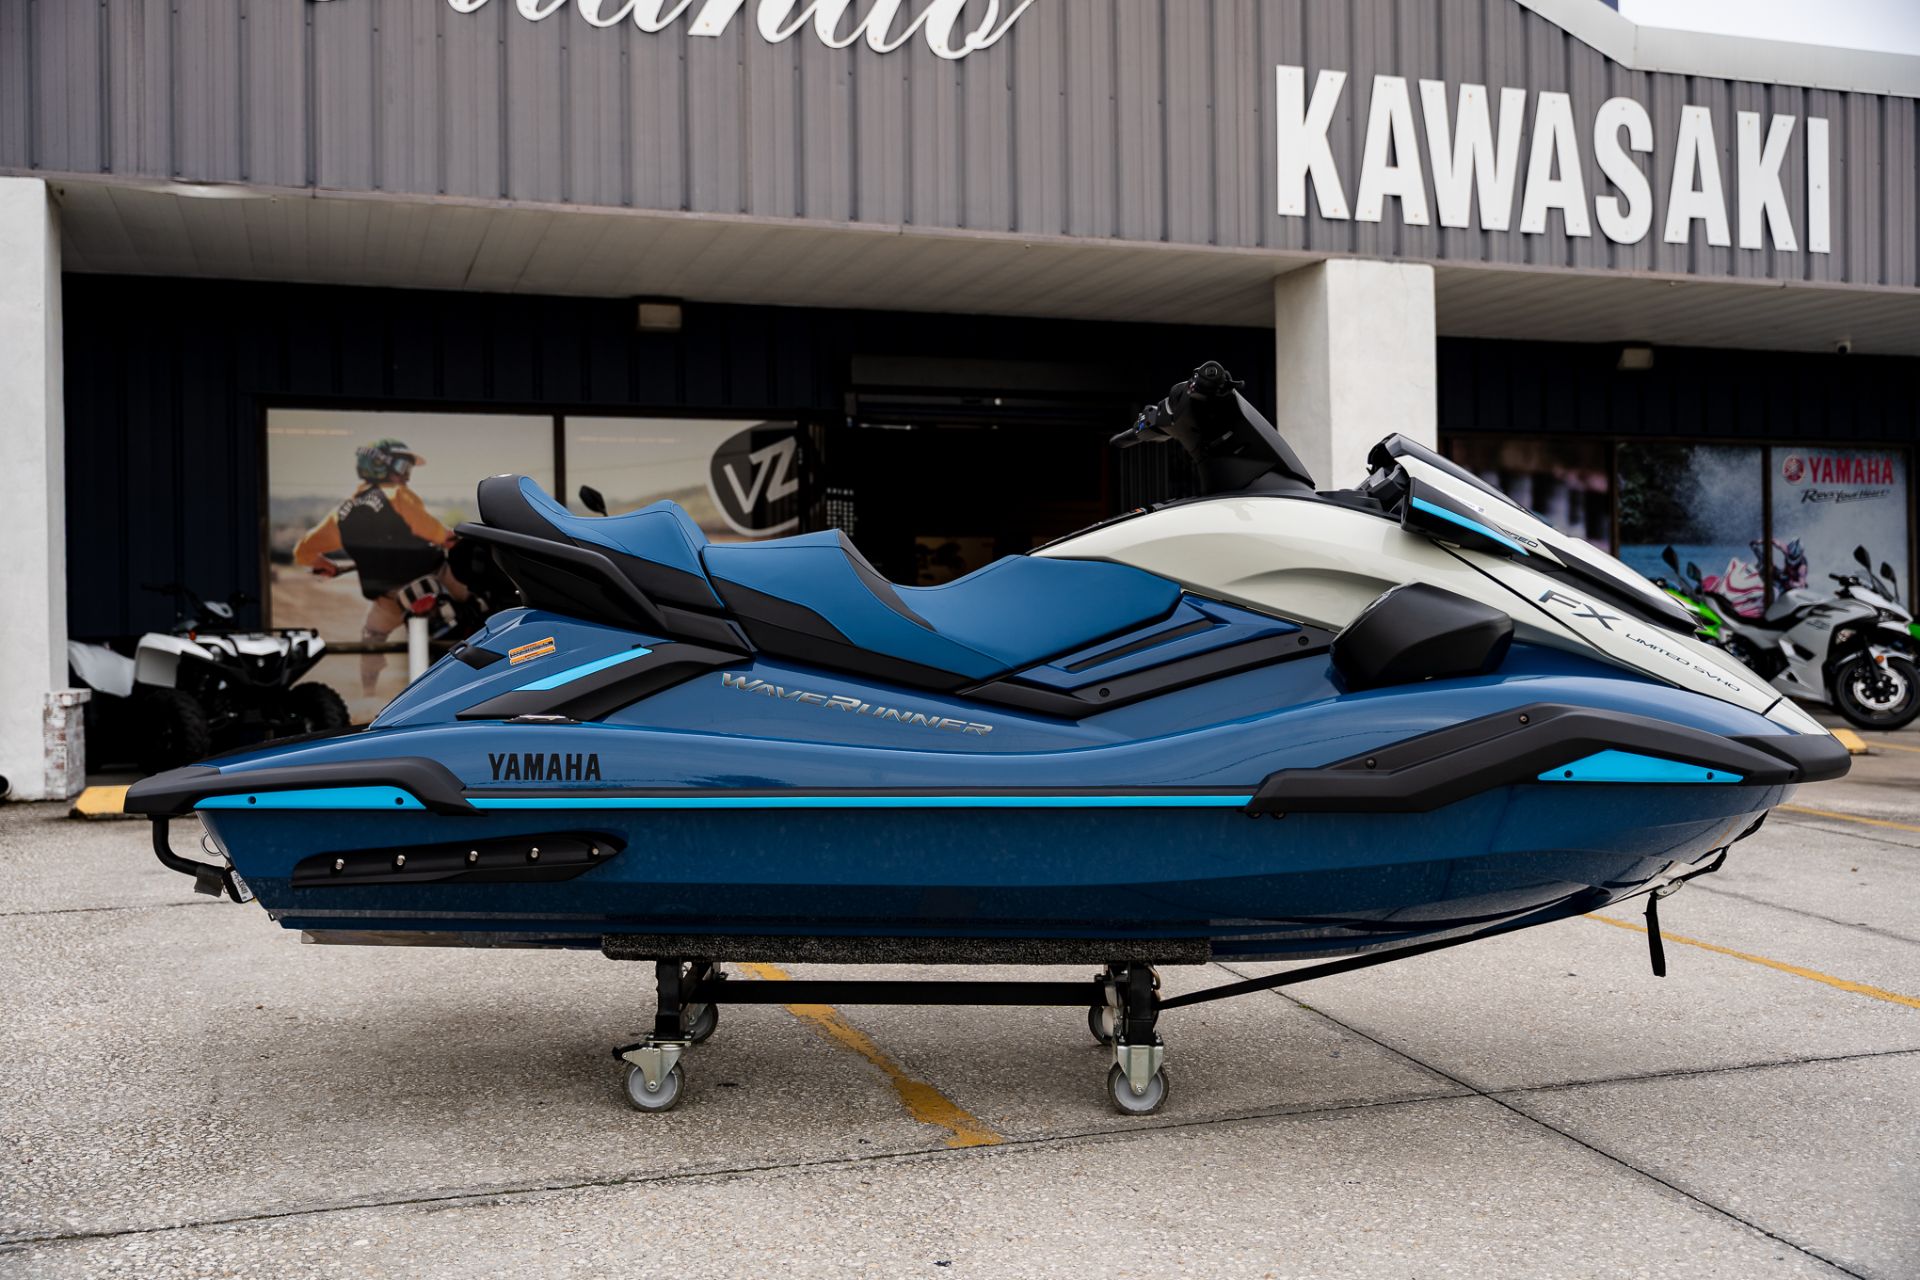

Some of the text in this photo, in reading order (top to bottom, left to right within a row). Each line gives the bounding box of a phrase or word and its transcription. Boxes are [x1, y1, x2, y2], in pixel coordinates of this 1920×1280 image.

[1276, 65, 1831, 254] KAWASAKI
[1808, 456, 1894, 485] YAMAHA
[1538, 589, 1741, 693] FX LIMITED SVHO
[488, 752, 601, 781] YAMAHA
